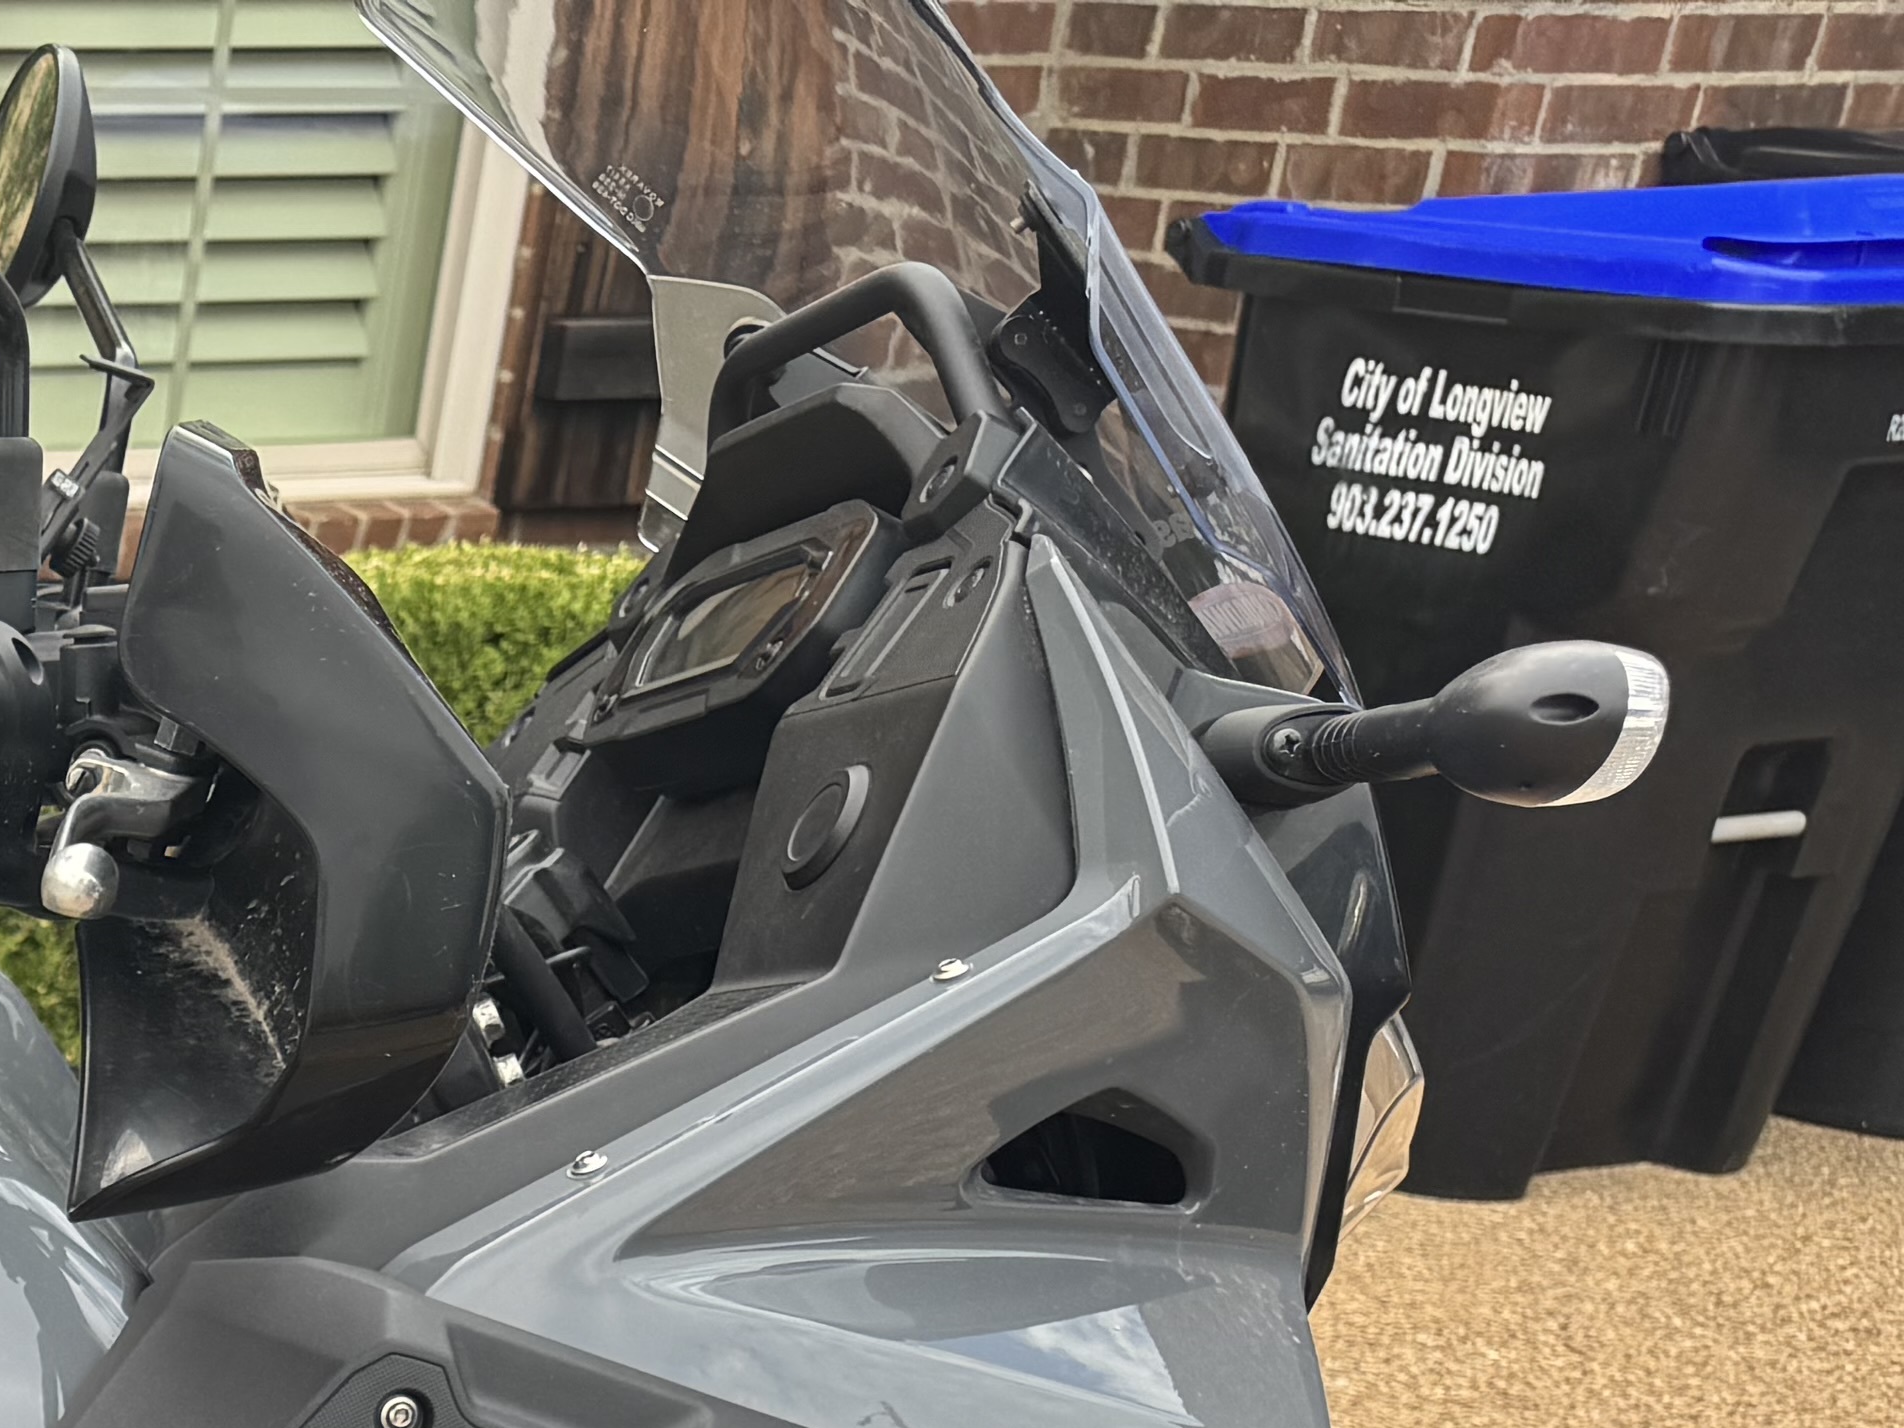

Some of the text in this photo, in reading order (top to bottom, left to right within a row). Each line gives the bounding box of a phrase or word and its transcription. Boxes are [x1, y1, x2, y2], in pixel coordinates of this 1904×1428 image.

[1340, 357, 1552, 438] City of Longview
[1311, 416, 1546, 500] Sanitation Division
[1327, 481, 1499, 555] 903.237.1250
